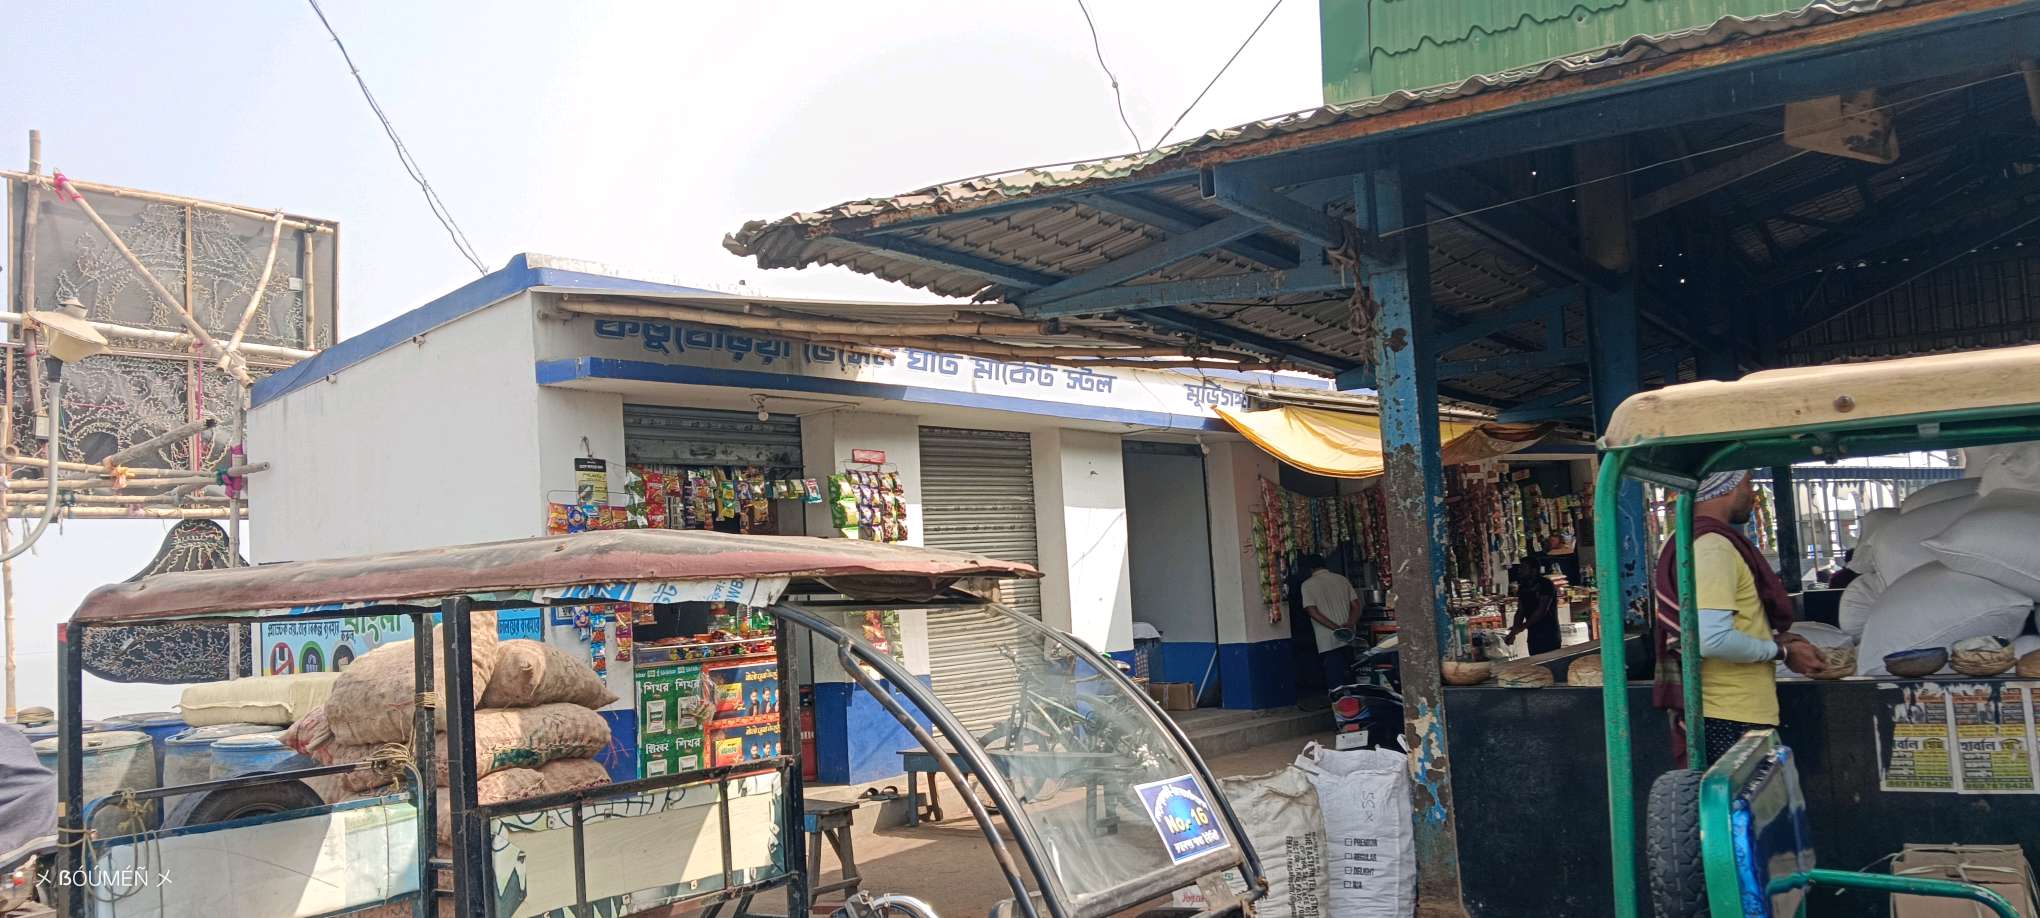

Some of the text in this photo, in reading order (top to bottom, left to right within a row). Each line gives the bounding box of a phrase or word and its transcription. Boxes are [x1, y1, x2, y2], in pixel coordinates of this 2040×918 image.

[1062, 368, 1118, 394] স্টল
[643, 682, 670, 694] শিখর
[676, 737, 702, 751] শিখর
[1191, 807, 1209, 827] 16
[1306, 846, 1316, 877] EASTERN
